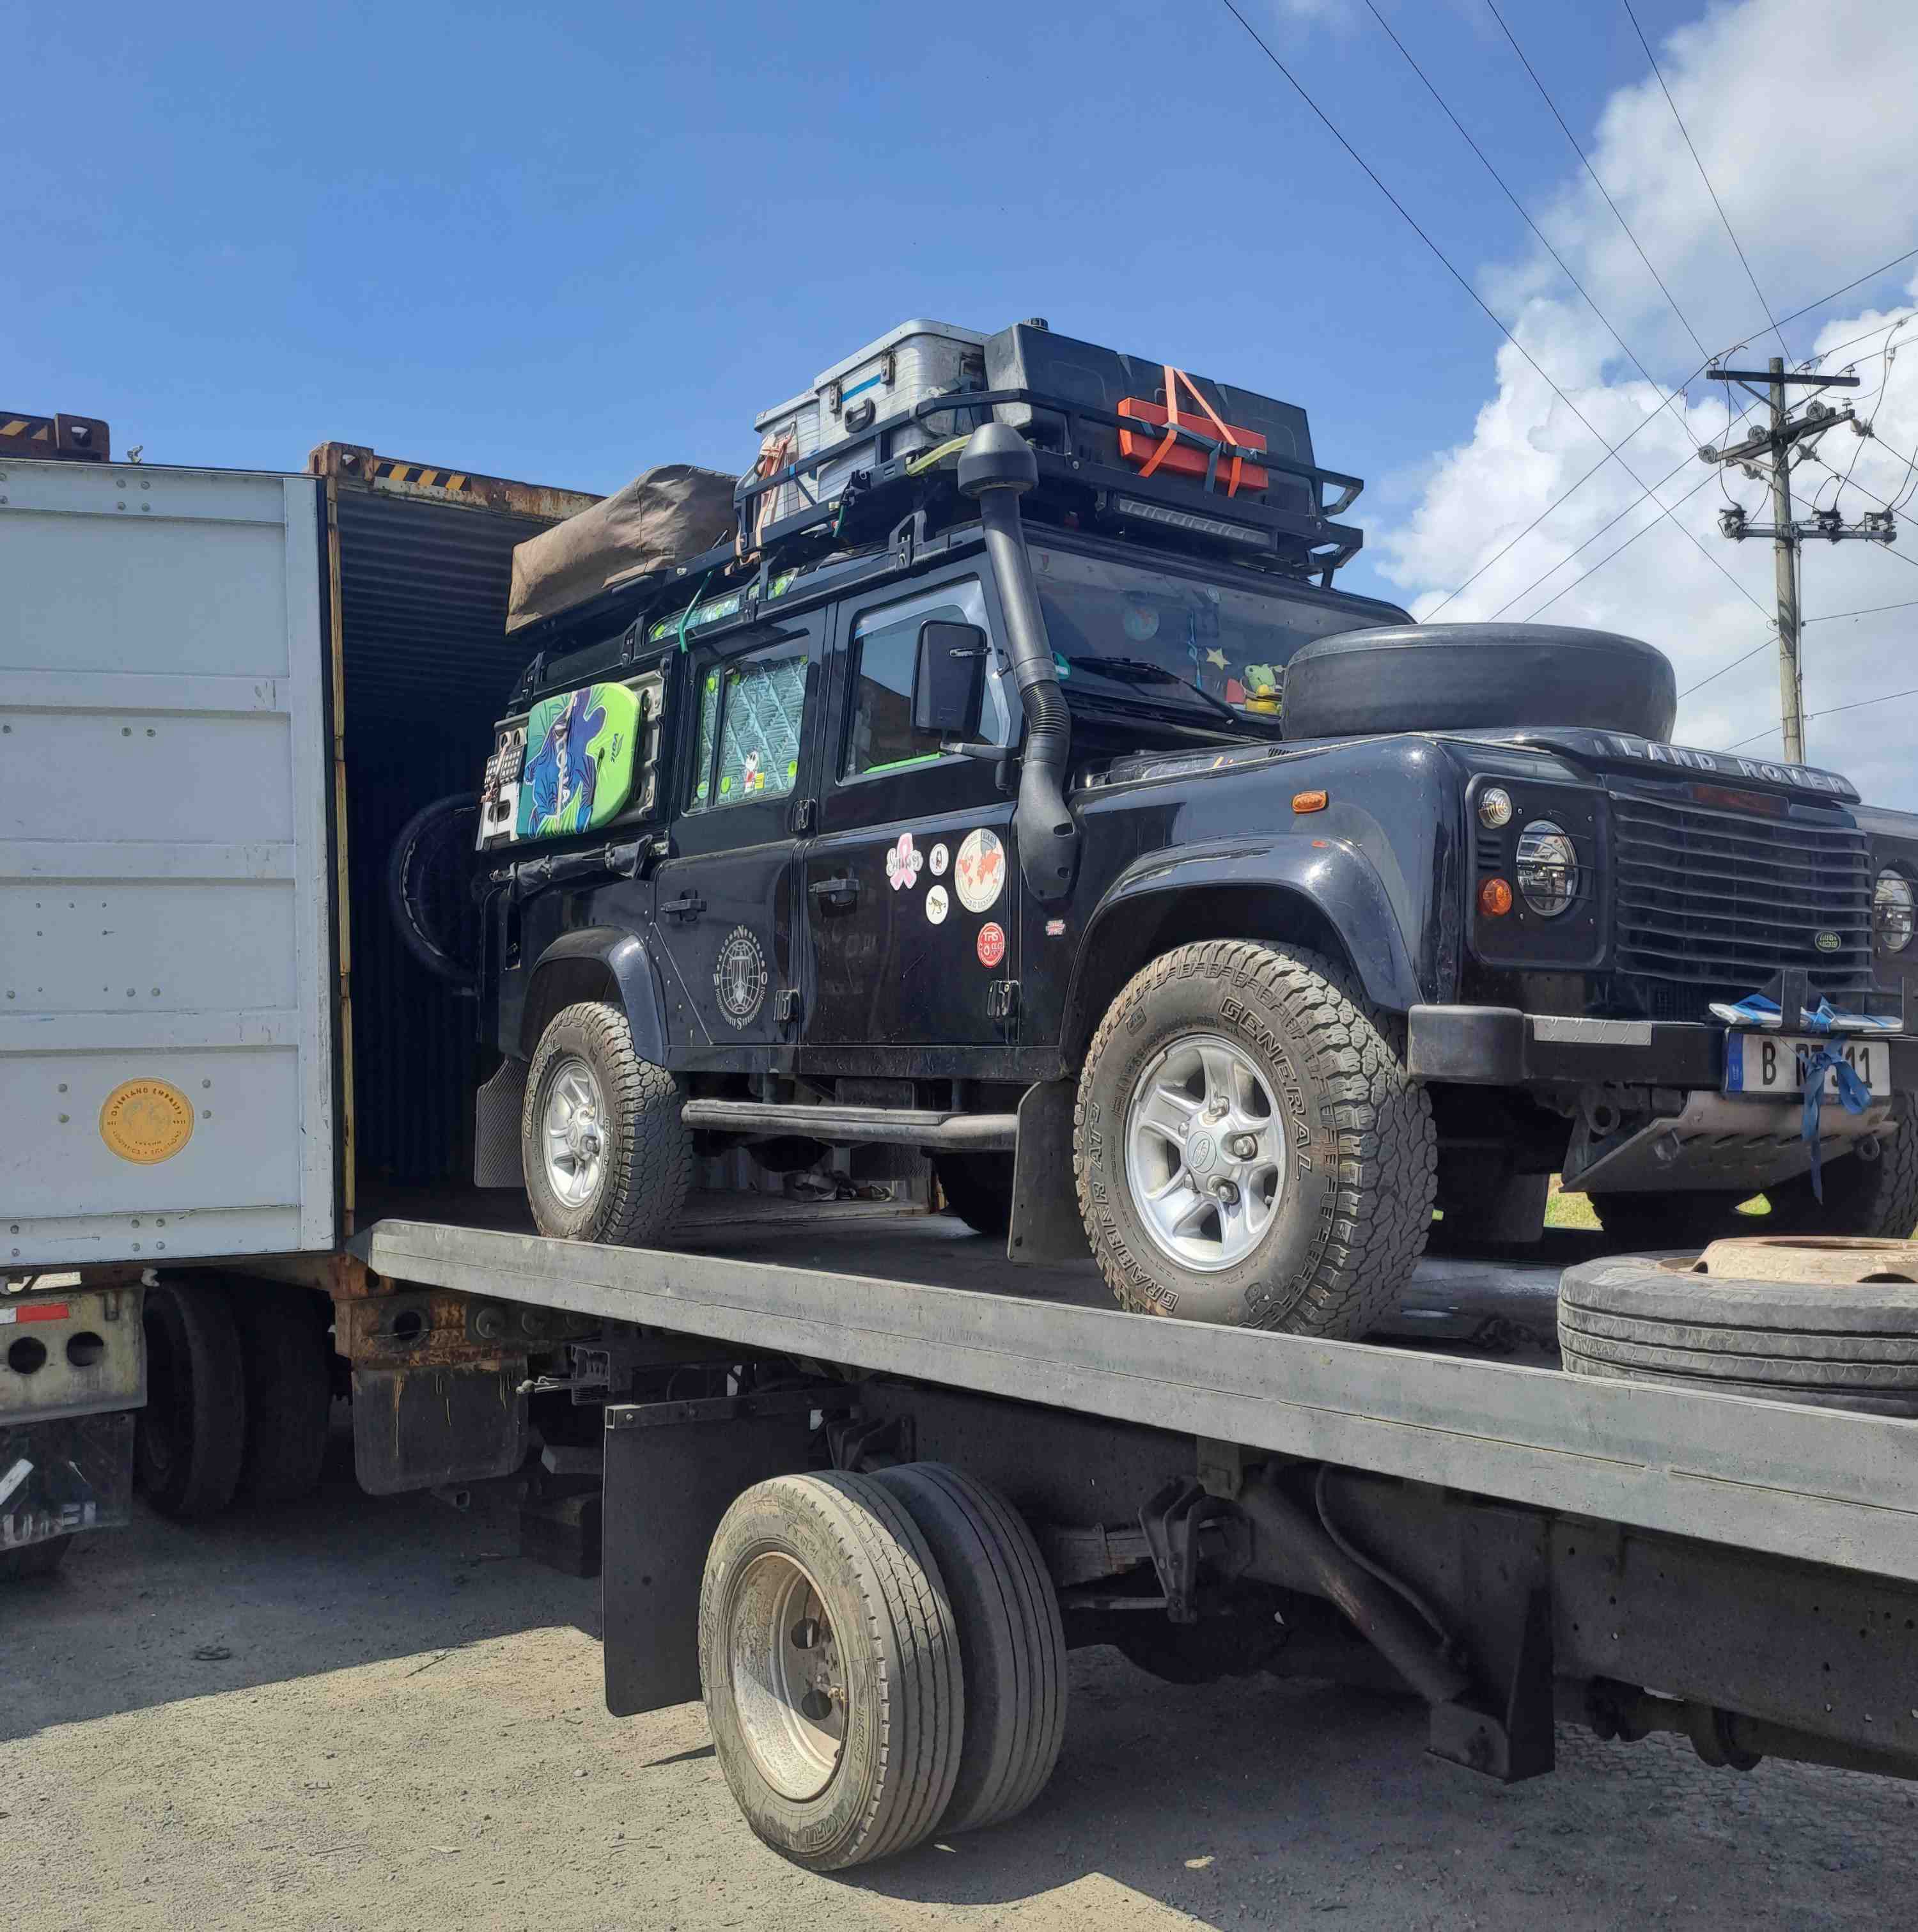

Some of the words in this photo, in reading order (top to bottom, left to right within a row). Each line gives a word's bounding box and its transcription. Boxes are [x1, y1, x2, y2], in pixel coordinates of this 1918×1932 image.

[1619, 738, 1717, 771] LAND
[1736, 758, 1849, 793] ROVER
[1219, 995, 1314, 1181] GENERAL
[1761, 1041, 1777, 1086] B
